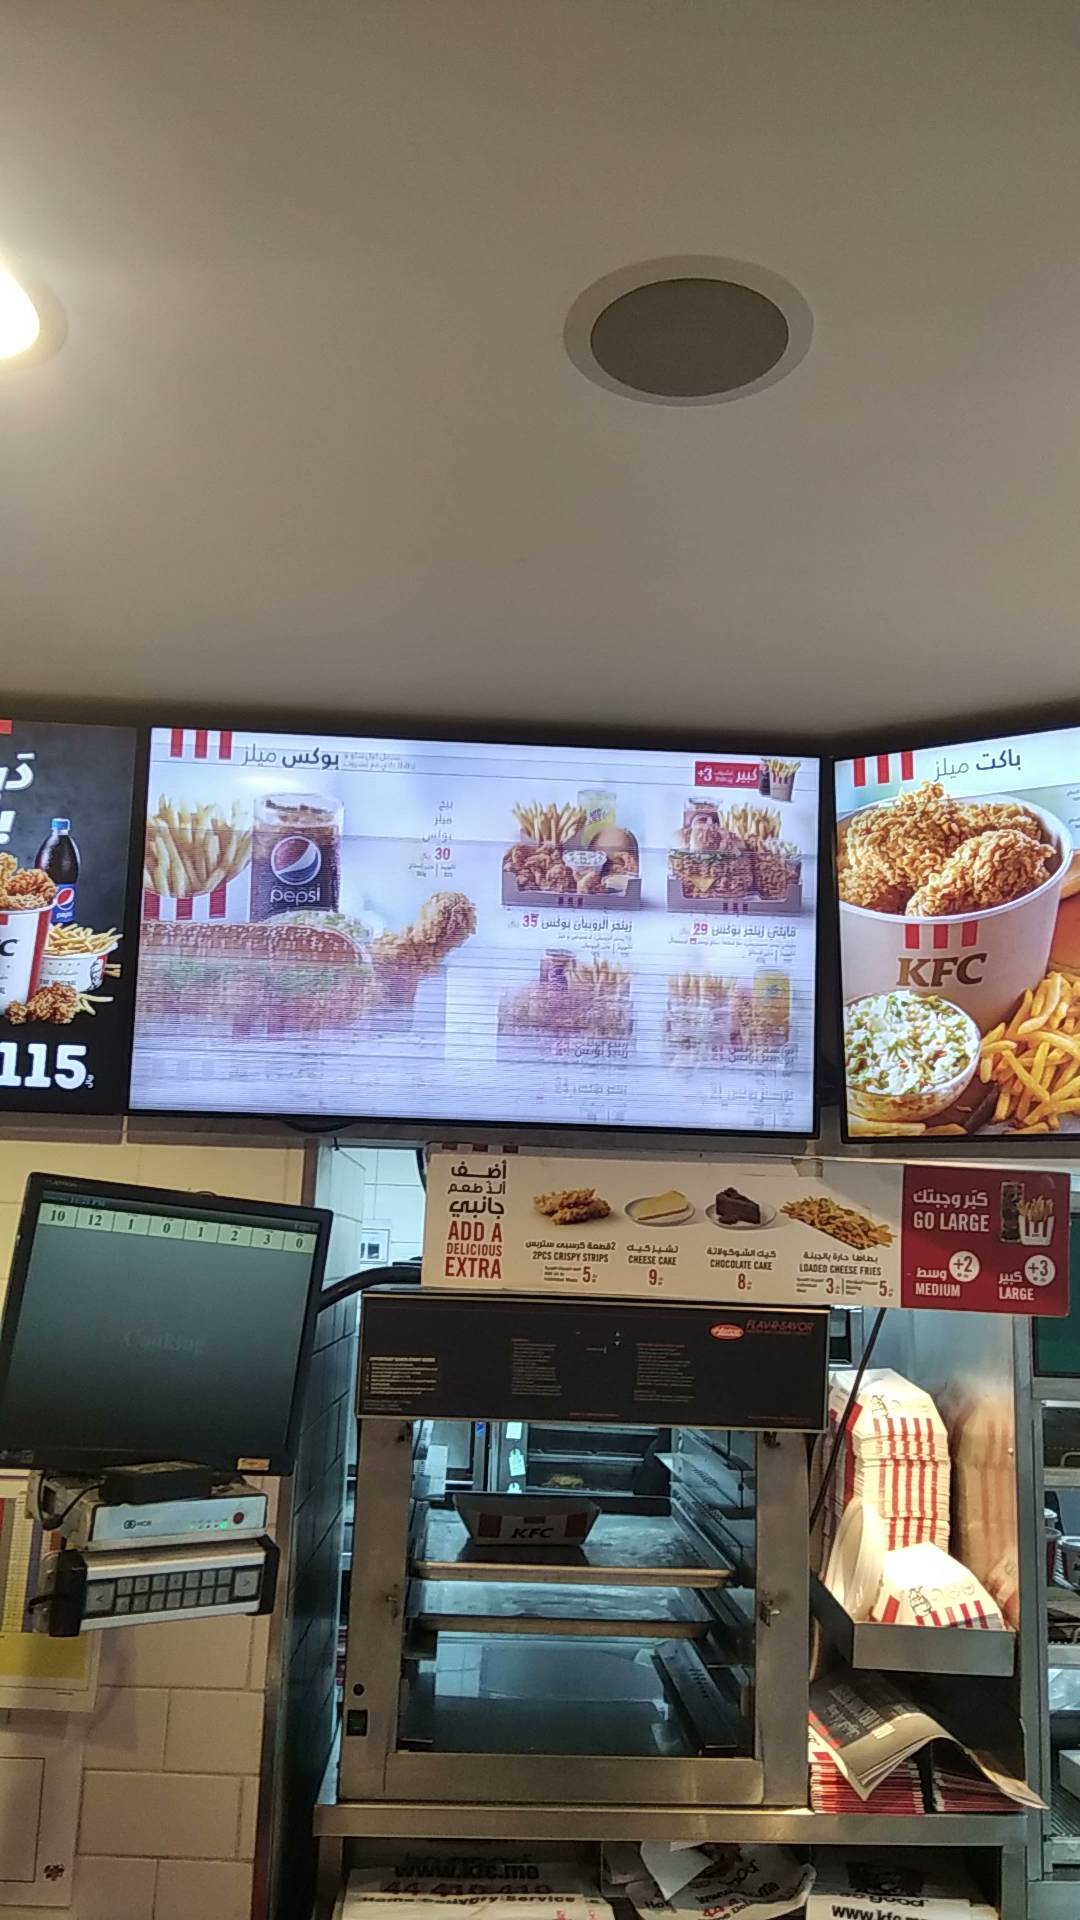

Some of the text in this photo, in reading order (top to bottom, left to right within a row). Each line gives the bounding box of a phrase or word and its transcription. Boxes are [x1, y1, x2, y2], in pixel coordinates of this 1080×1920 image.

[282, 747, 340, 771] بوكس
[934, 748, 1021, 782] باكت ميلز
[735, 768, 758, 784] كبير
[434, 846, 451, 861] 30
[270, 886, 320, 906] pepsi
[693, 922, 708, 936] 29
[896, 953, 988, 987] KFC
[447, 1183, 484, 1195] طعم
[448, 1196, 505, 1220] جانبي
[50, 1209, 66, 1222] 10
[88, 1214, 102, 1226] 12
[913, 1211, 990, 1232] GO LARGE
[128, 1217, 134, 1230] 1
[163, 1222, 171, 1234] 0
[198, 1226, 204, 1238] 1
[231, 1230, 239, 1242] 2
[447, 1220, 503, 1243] ADD A
[263, 1234, 271, 1245] 3
[296, 1237, 303, 1249] 0
[446, 1242, 502, 1257] DELICIOUS
[532, 1251, 609, 1263] 2PCS CRISPY STRIPS
[628, 1255, 677, 1265] CHEESE CAKE
[443, 1256, 502, 1280] EXTRA
[710, 1259, 773, 1270] CHOCOLATE CAKE
[799, 1263, 881, 1276] LOADED CHEESE FRIES
[582, 1266, 591, 1283] 5
[648, 1268, 658, 1286] 9
[916, 1267, 947, 1281] وسط
[998, 1271, 1023, 1285] كبير
[737, 1273, 746, 1290] 8
[826, 1277, 834, 1294] 3
[879, 1280, 887, 1296] 5
[915, 1283, 960, 1297] MEDIUM
[998, 1287, 1034, 1301] LARGE
[511, 1527, 555, 1539] KFC
